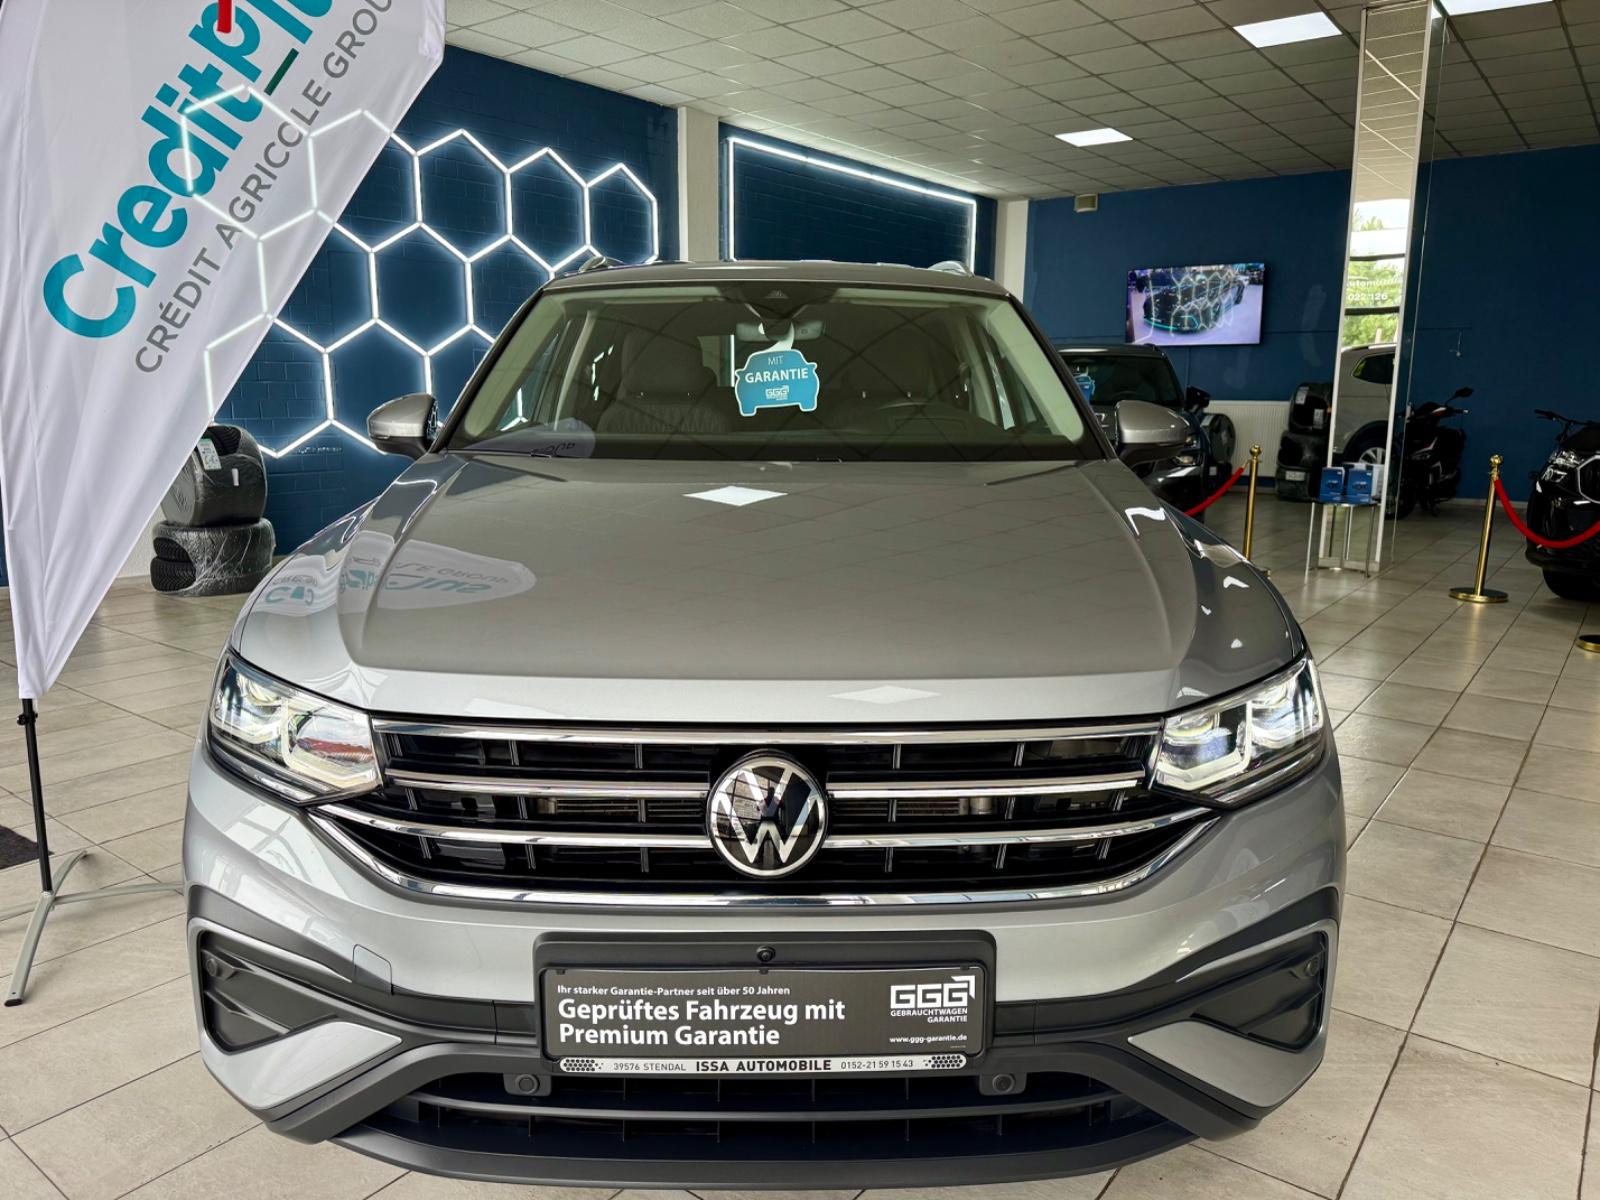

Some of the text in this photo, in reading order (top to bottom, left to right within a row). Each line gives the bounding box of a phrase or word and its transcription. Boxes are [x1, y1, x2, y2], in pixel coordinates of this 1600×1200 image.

[136, 248, 221, 373] CRÉDIT
[768, 355, 784, 366] MIT
[745, 367, 809, 384] GARANTIE
[557, 984, 790, 996] Ihr starker Garantie-Partner seit über 50 Jahren
[890, 983, 968, 1009] GGG
[558, 998, 846, 1025] Geprüftes Fahrzeug mit
[890, 1008, 968, 1017] GEBRAUCHTWAGEN
[927, 1015, 968, 1023] GARANTIE
[559, 1023, 780, 1045] Premium Garantie
[889, 1034, 968, 1044] www.ggg-garantie.de
[613, 1062, 640, 1072] 39576
[643, 1062, 687, 1072] STENDAL
[696, 1061, 729, 1073] ISSA
[736, 1060, 832, 1073] AUTOMOBILE
